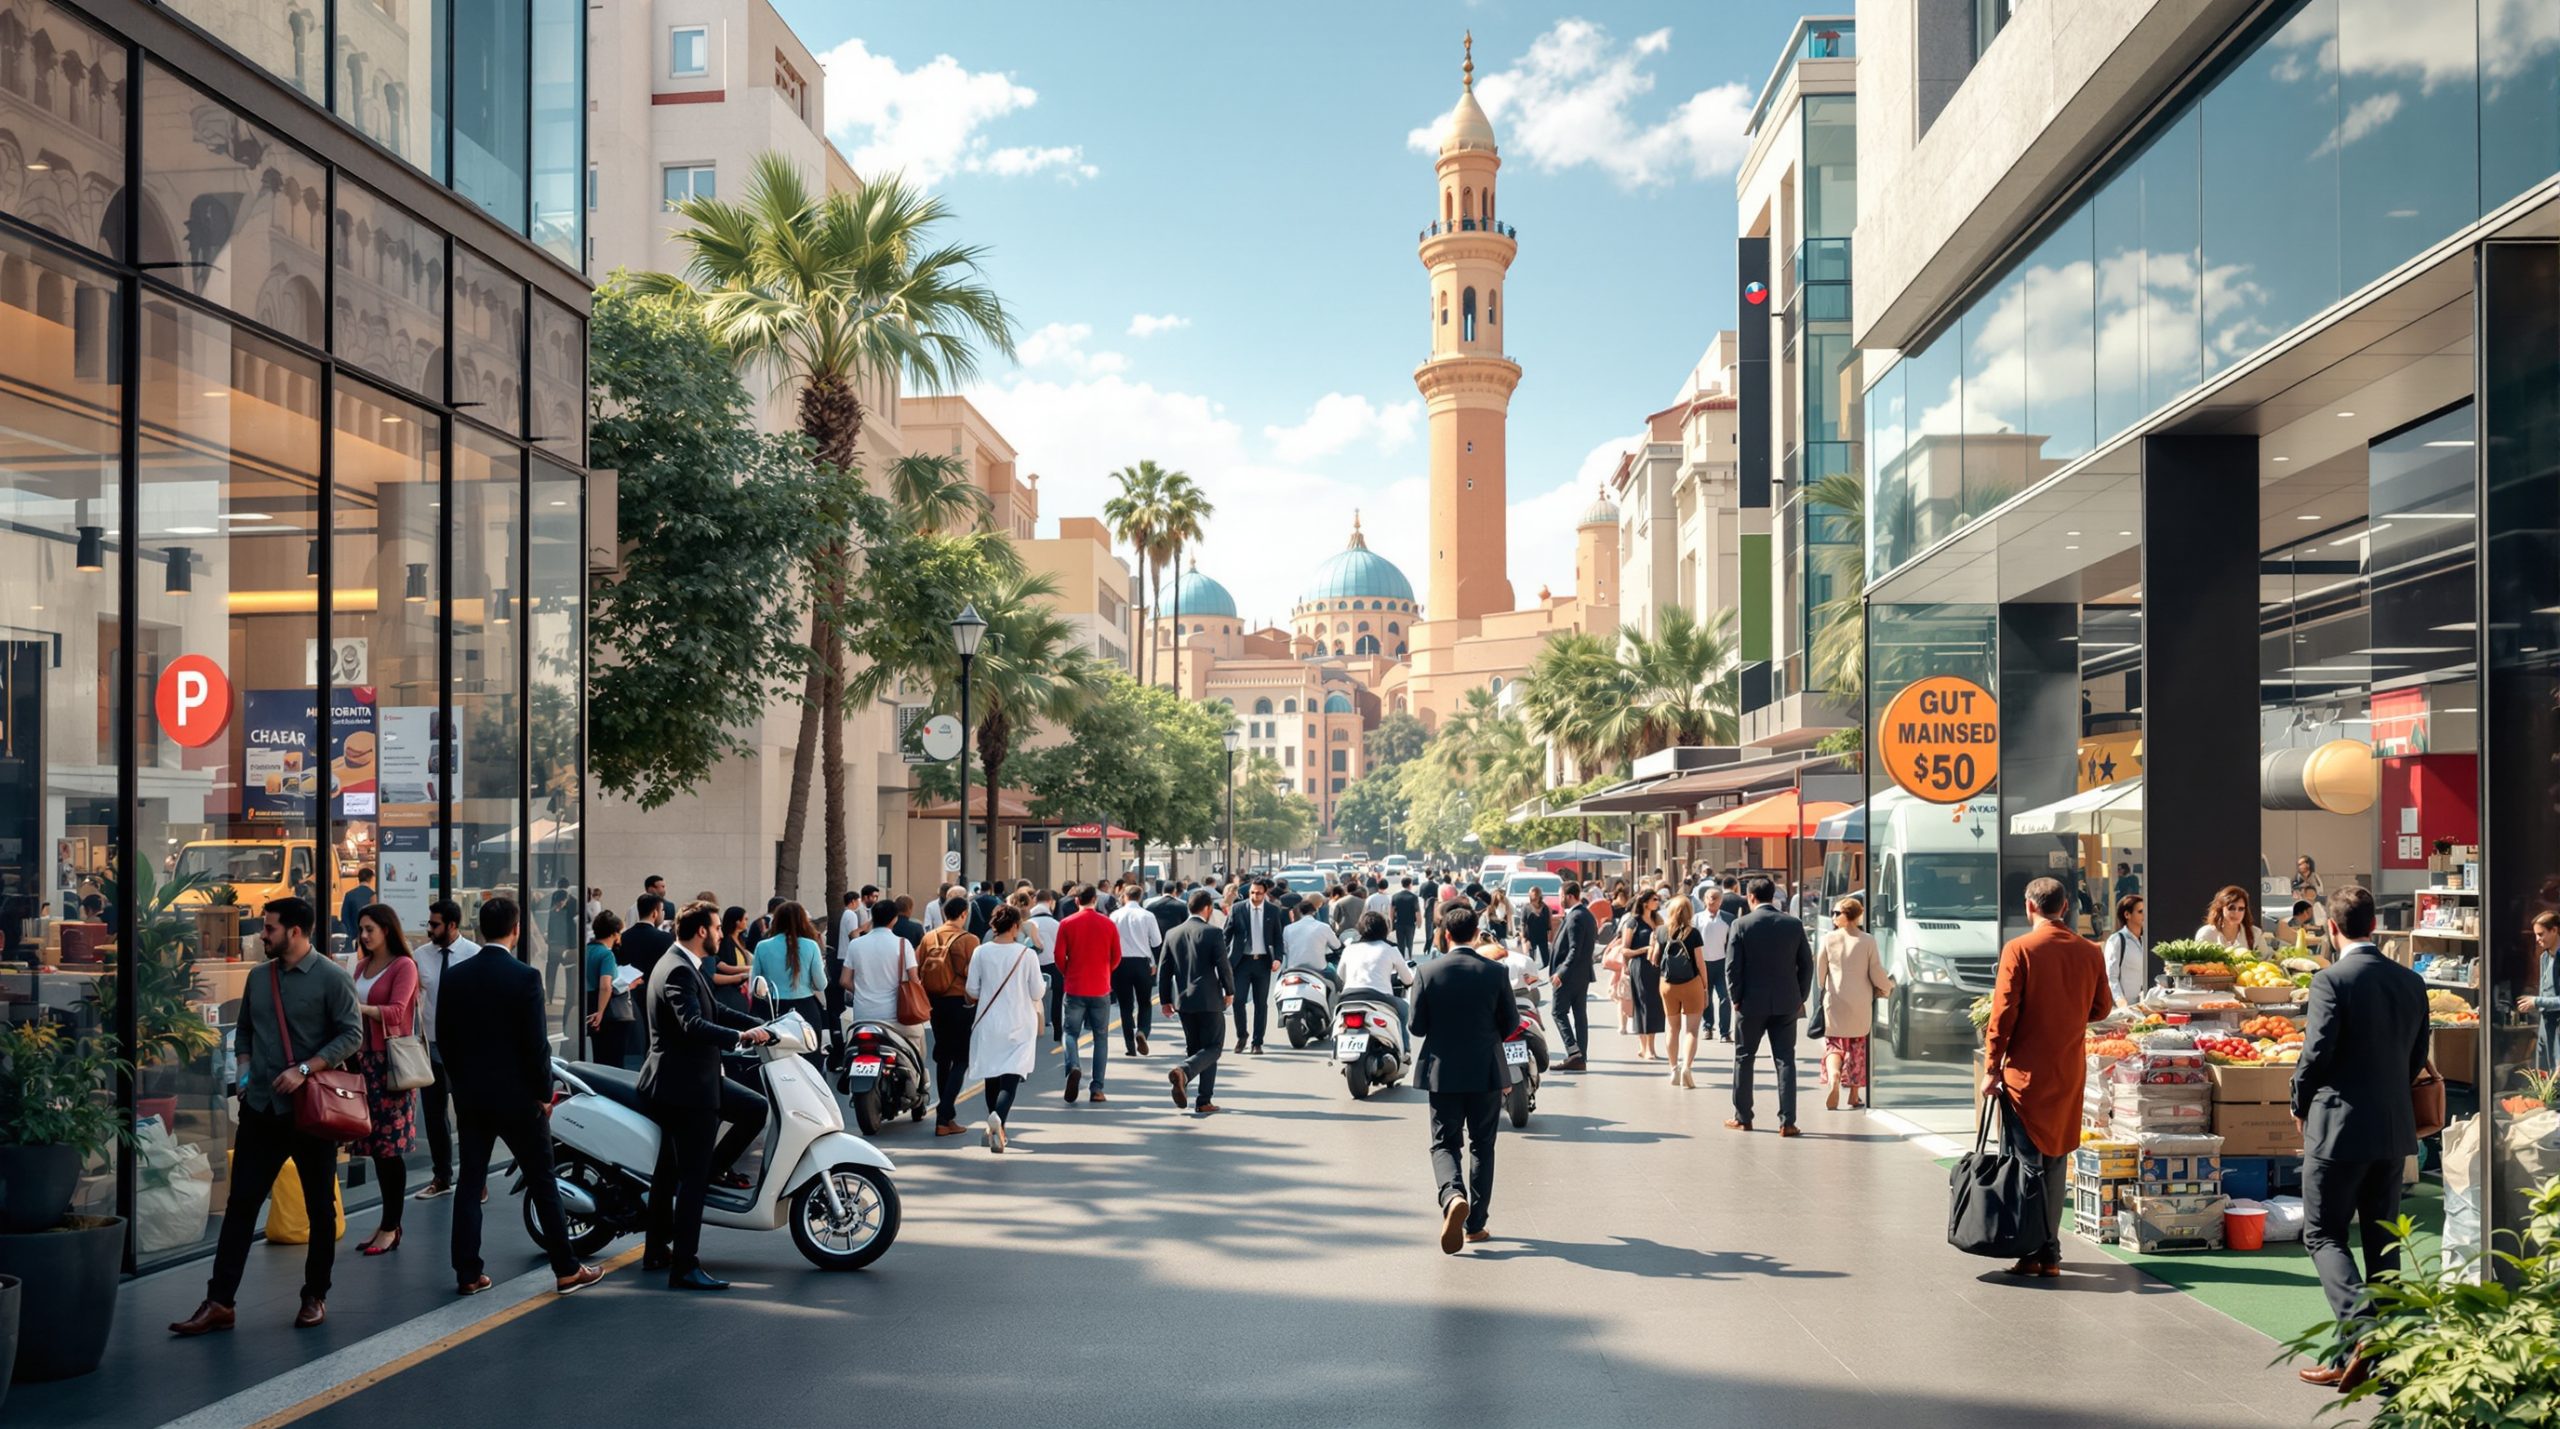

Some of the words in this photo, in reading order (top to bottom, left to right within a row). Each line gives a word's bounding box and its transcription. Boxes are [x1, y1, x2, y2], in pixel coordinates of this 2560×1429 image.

[177, 670, 208, 727] P
[1919, 689, 1976, 715] GUT
[1898, 723, 1997, 744] MAINSED
[1914, 752, 1975, 790] $50
